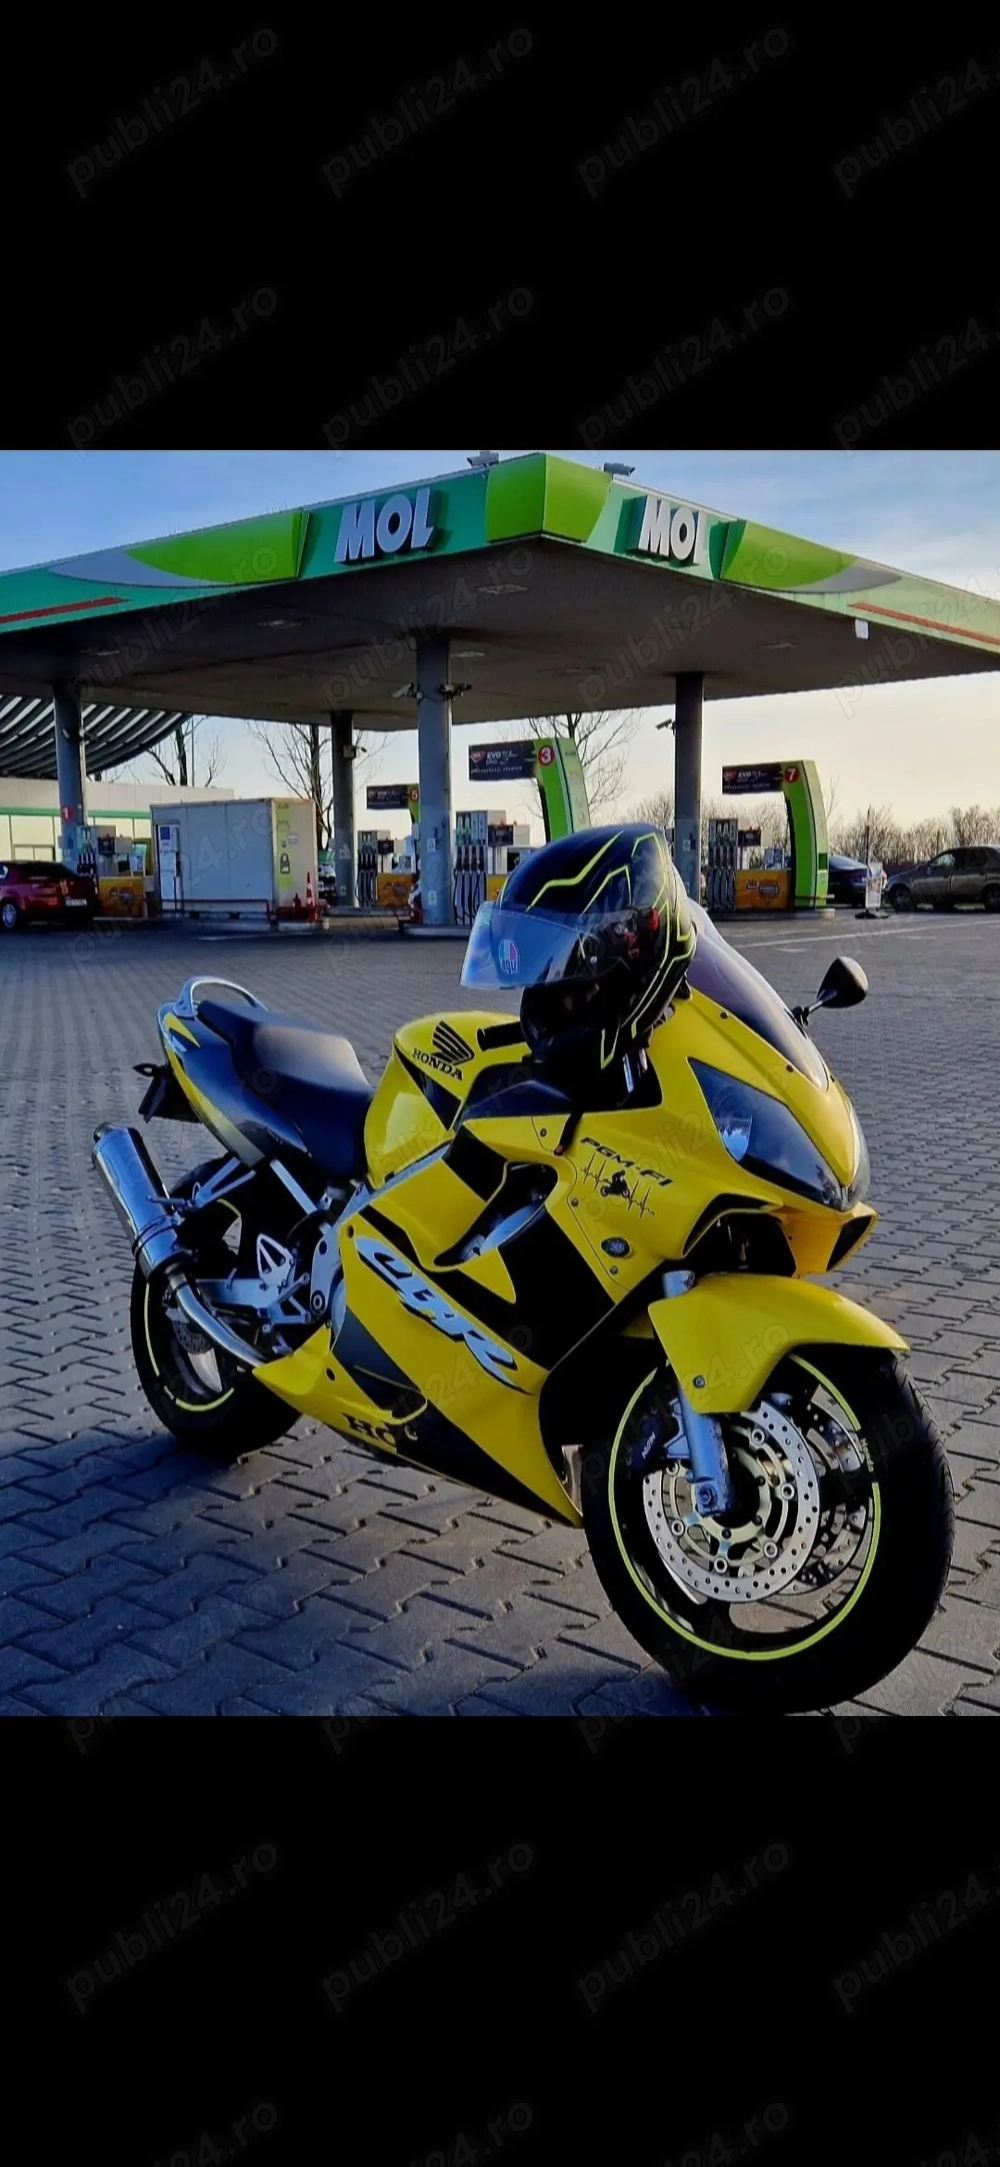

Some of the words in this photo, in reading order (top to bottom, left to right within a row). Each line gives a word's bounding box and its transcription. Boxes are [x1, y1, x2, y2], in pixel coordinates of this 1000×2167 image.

[335, 487, 435, 563] MOL
[541, 747, 551, 763] 3
[788, 768, 796, 781] 7
[412, 1048, 463, 1081] HONDA
[580, 1137, 673, 1187] PGM-FI
